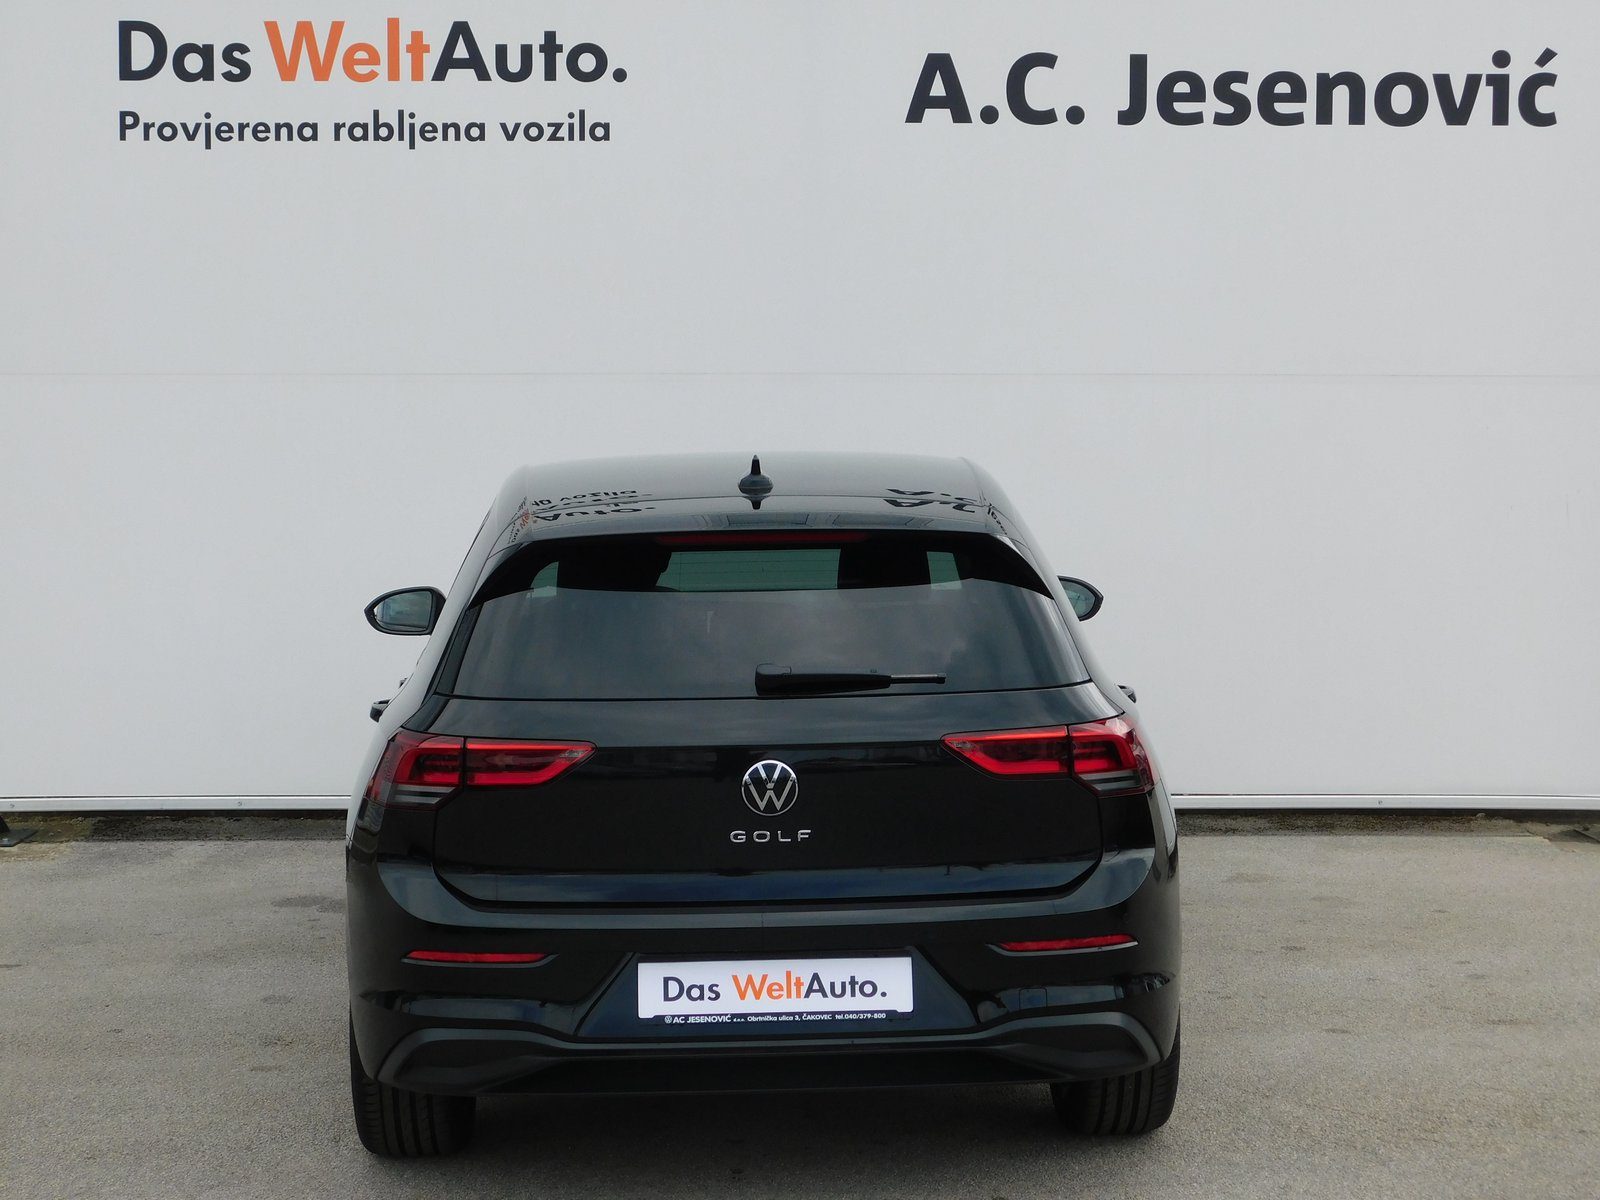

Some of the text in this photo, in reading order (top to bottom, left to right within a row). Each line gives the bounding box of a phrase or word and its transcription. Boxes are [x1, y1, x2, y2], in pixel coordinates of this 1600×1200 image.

[119, 18, 627, 82] Das WeltAuto.
[905, 48, 1557, 127] A.C. Jesenović
[119, 108, 611, 150] Provjerena rabljena vozila
[729, 829, 812, 843] GOLF
[662, 970, 888, 1002] Das WeltAuto.
[673, 1016, 685, 1024] AC
[686, 1013, 732, 1024] JESENOVIĆ
[778, 1014, 794, 1022] ulica
[802, 1012, 832, 1021] ČAKOVEC
